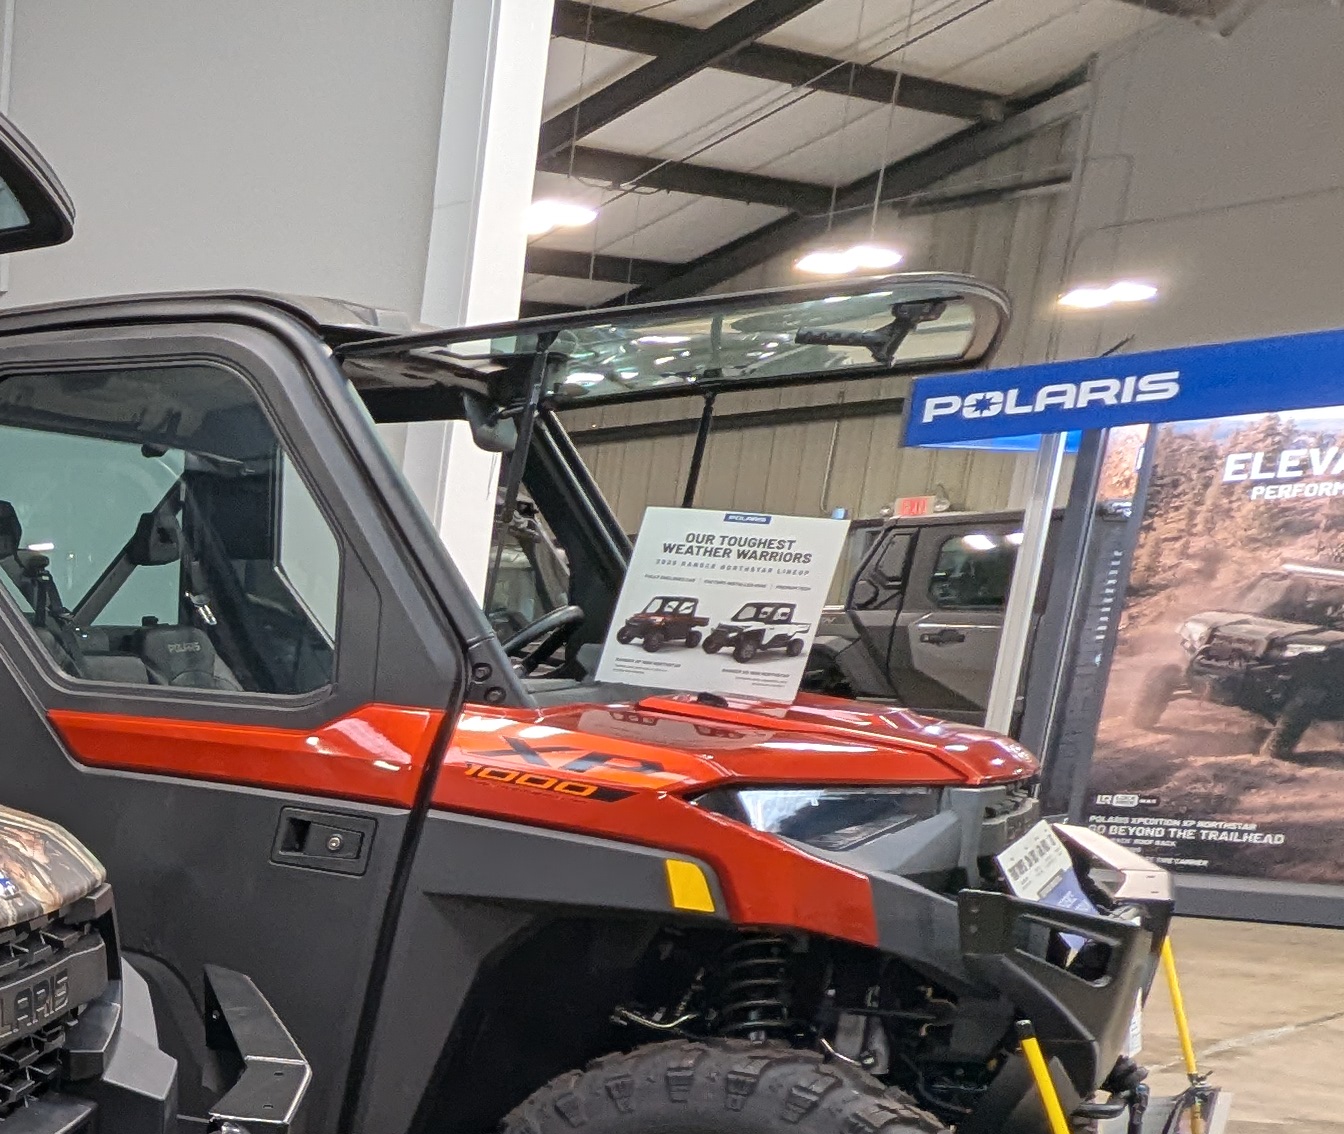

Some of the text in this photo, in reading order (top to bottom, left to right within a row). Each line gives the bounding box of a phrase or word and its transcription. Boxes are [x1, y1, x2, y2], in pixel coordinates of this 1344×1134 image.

[922, 371, 1180, 423] POLARIS
[685, 532, 796, 551] OUR TOUGHEST
[662, 542, 813, 564] WEATHER WARRIORS
[680, 560, 716, 570] RANGER
[720, 564, 773, 574] NORTHSTAR
[467, 735, 665, 773] XP
[464, 763, 599, 797] 1000
[1089, 815, 1130, 824] POLARIS
[1108, 826, 1165, 838] BEYOND
[1168, 828, 1196, 840] THE
[1200, 831, 1285, 845] TRAILHEAD
